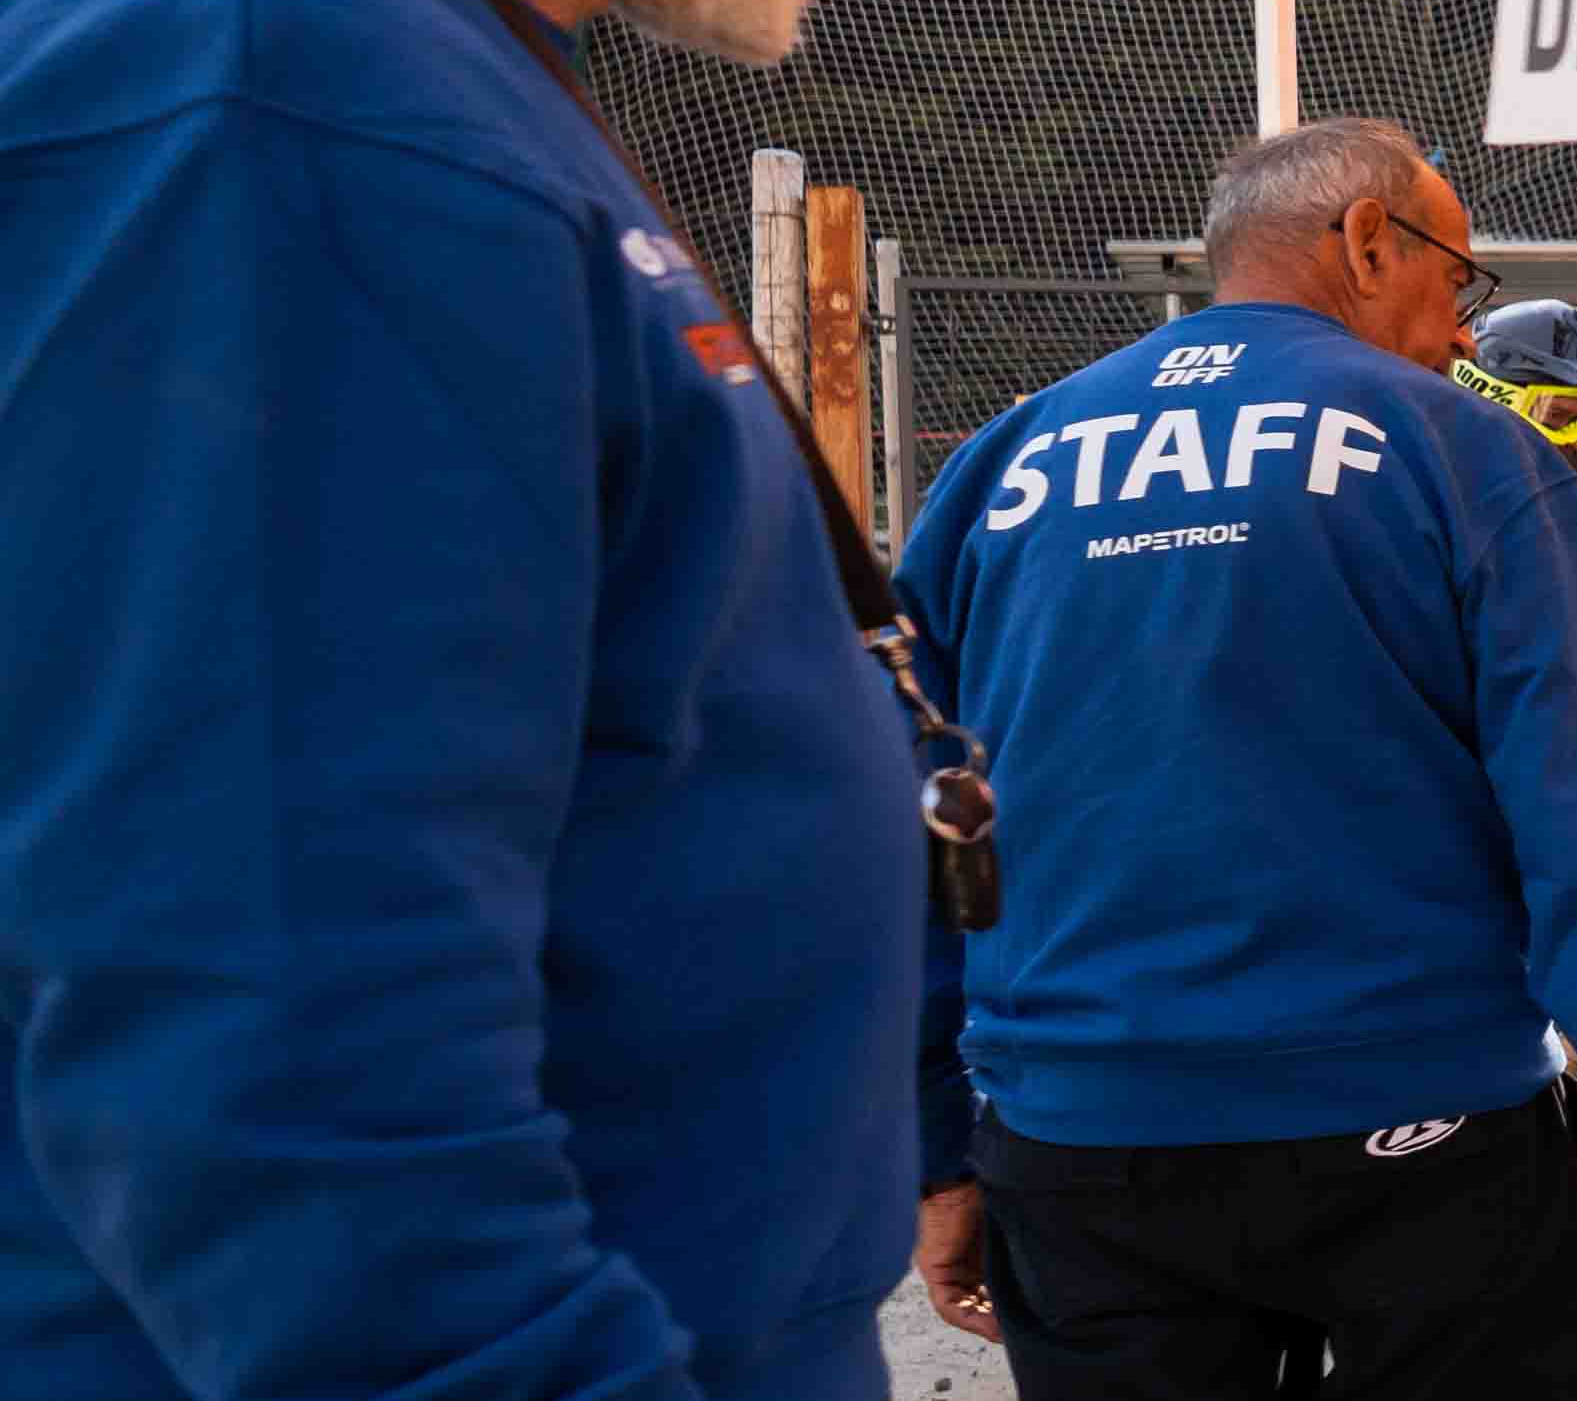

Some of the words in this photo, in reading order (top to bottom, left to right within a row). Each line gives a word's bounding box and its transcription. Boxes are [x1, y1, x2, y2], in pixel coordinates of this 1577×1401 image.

[1159, 342, 1248, 370] ON
[1150, 365, 1240, 387] OFF
[1455, 364, 1516, 406] 100%
[985, 402, 1387, 532] STAFF
